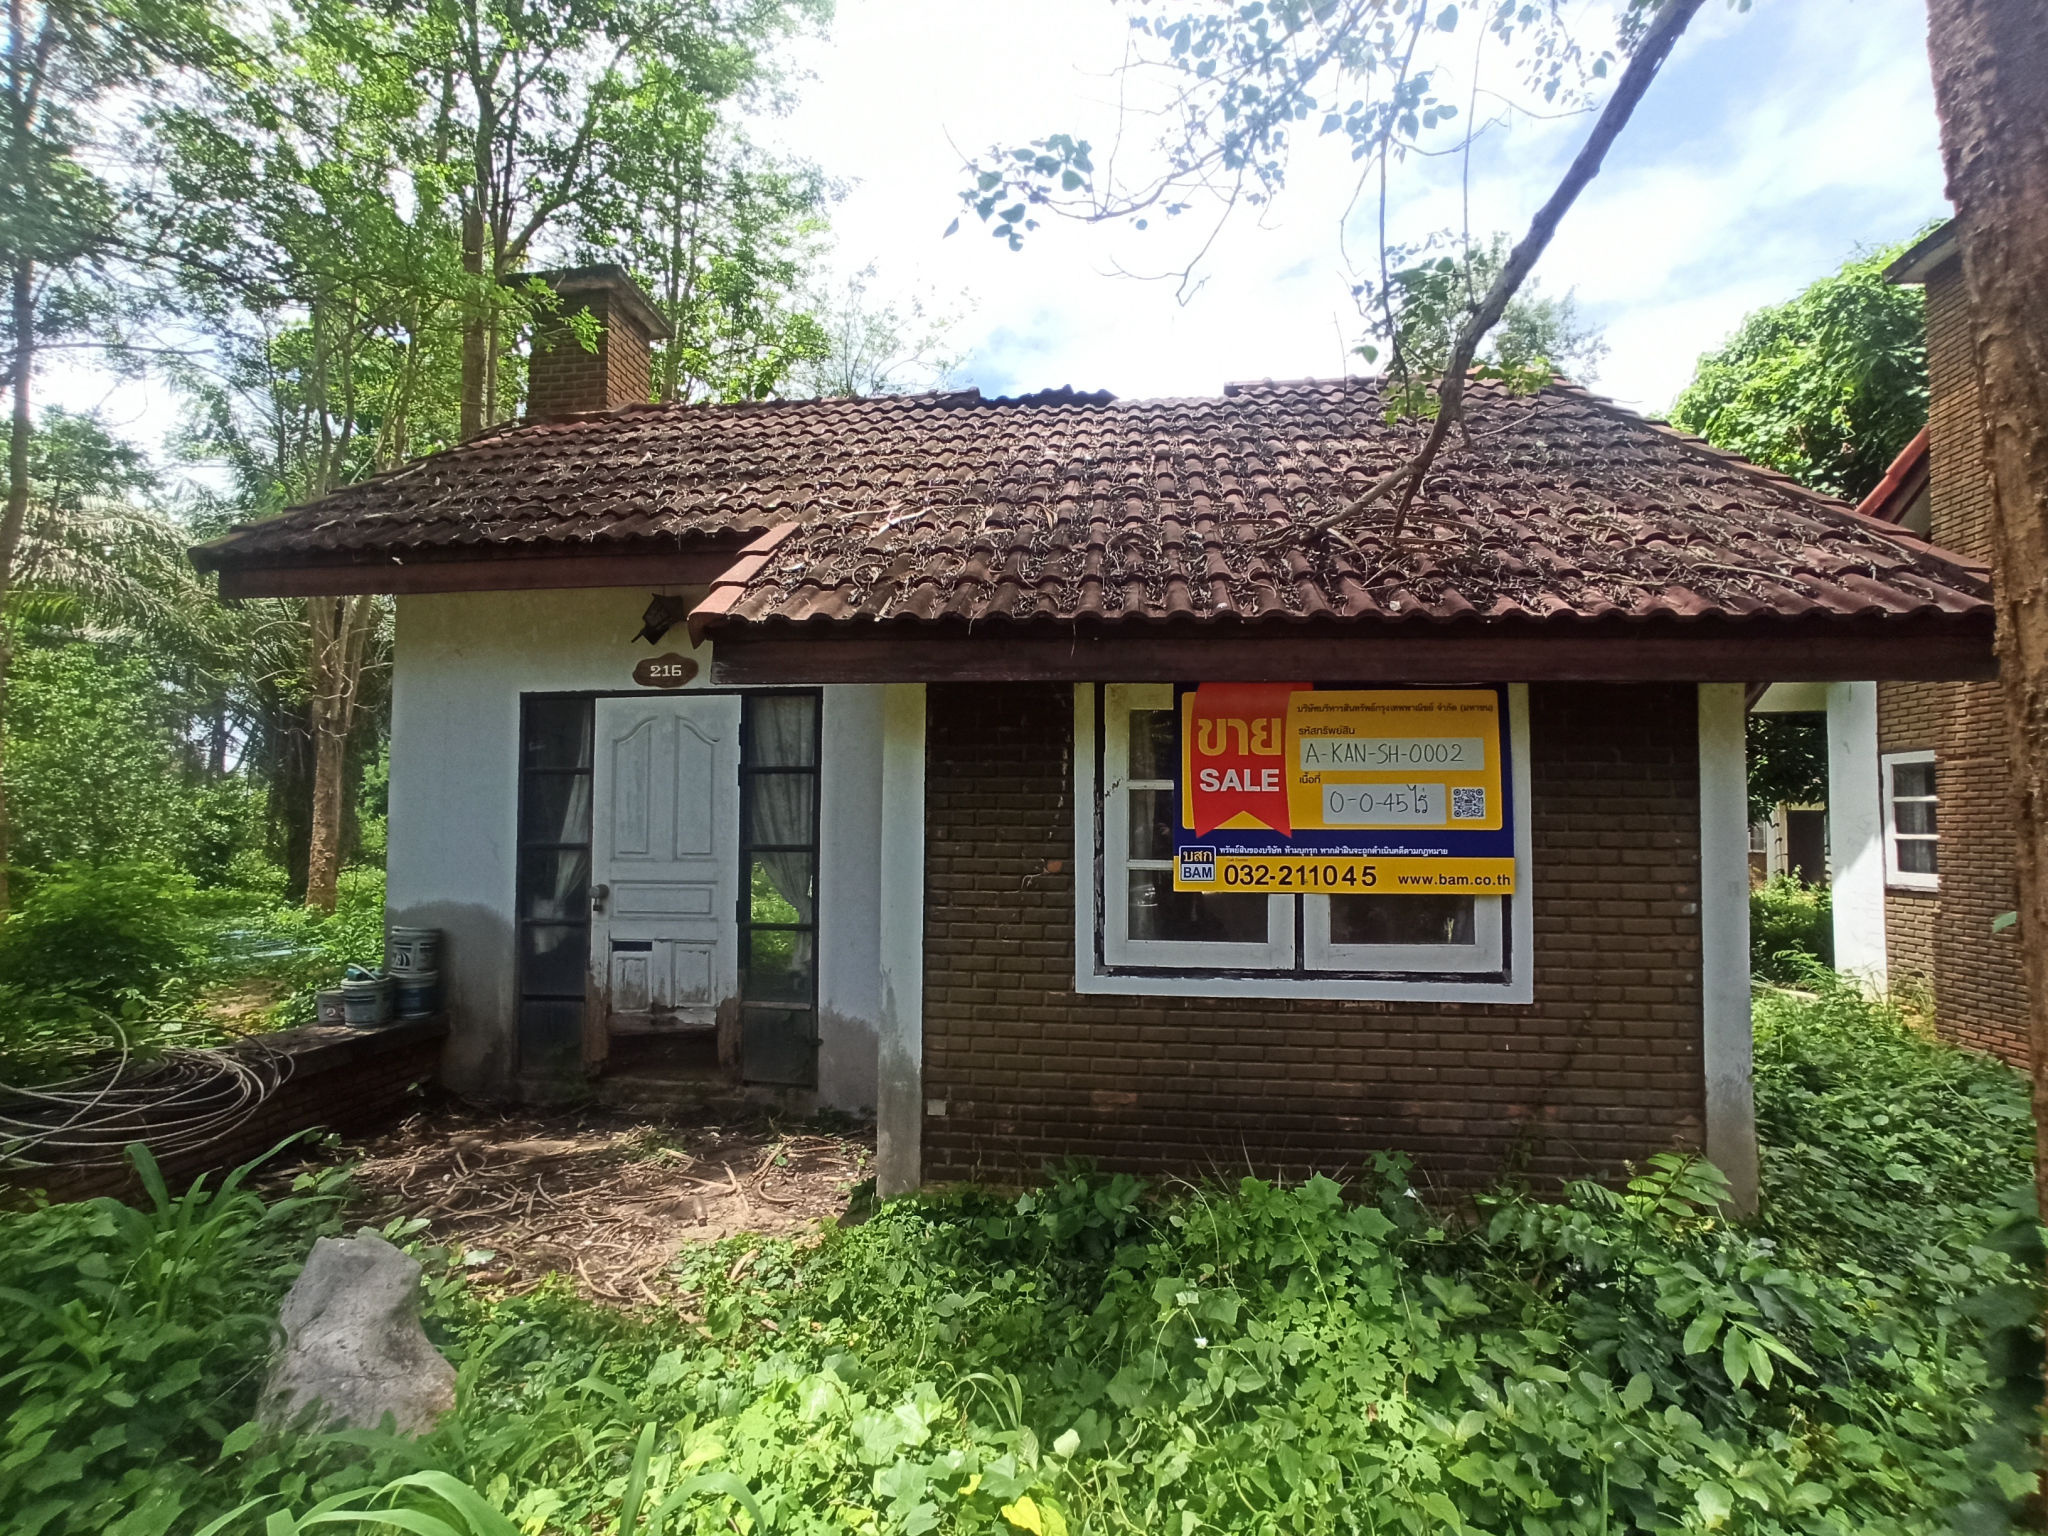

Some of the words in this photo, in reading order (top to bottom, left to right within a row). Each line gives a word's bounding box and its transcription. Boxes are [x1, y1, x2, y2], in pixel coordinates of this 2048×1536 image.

[650, 665, 682, 677] 216
[1198, 718, 1282, 757] ขาย
[1305, 742, 1464, 764] A-KAN-SH-0002
[1199, 768, 1280, 792] SALE
[1299, 773, 1321, 784] เนื้อที่
[1183, 850, 1213, 863] บสก
[1183, 866, 1213, 878] BAM
[1224, 864, 1377, 887] 032-211045
[1398, 873, 1511, 885] www.bam.co.th
